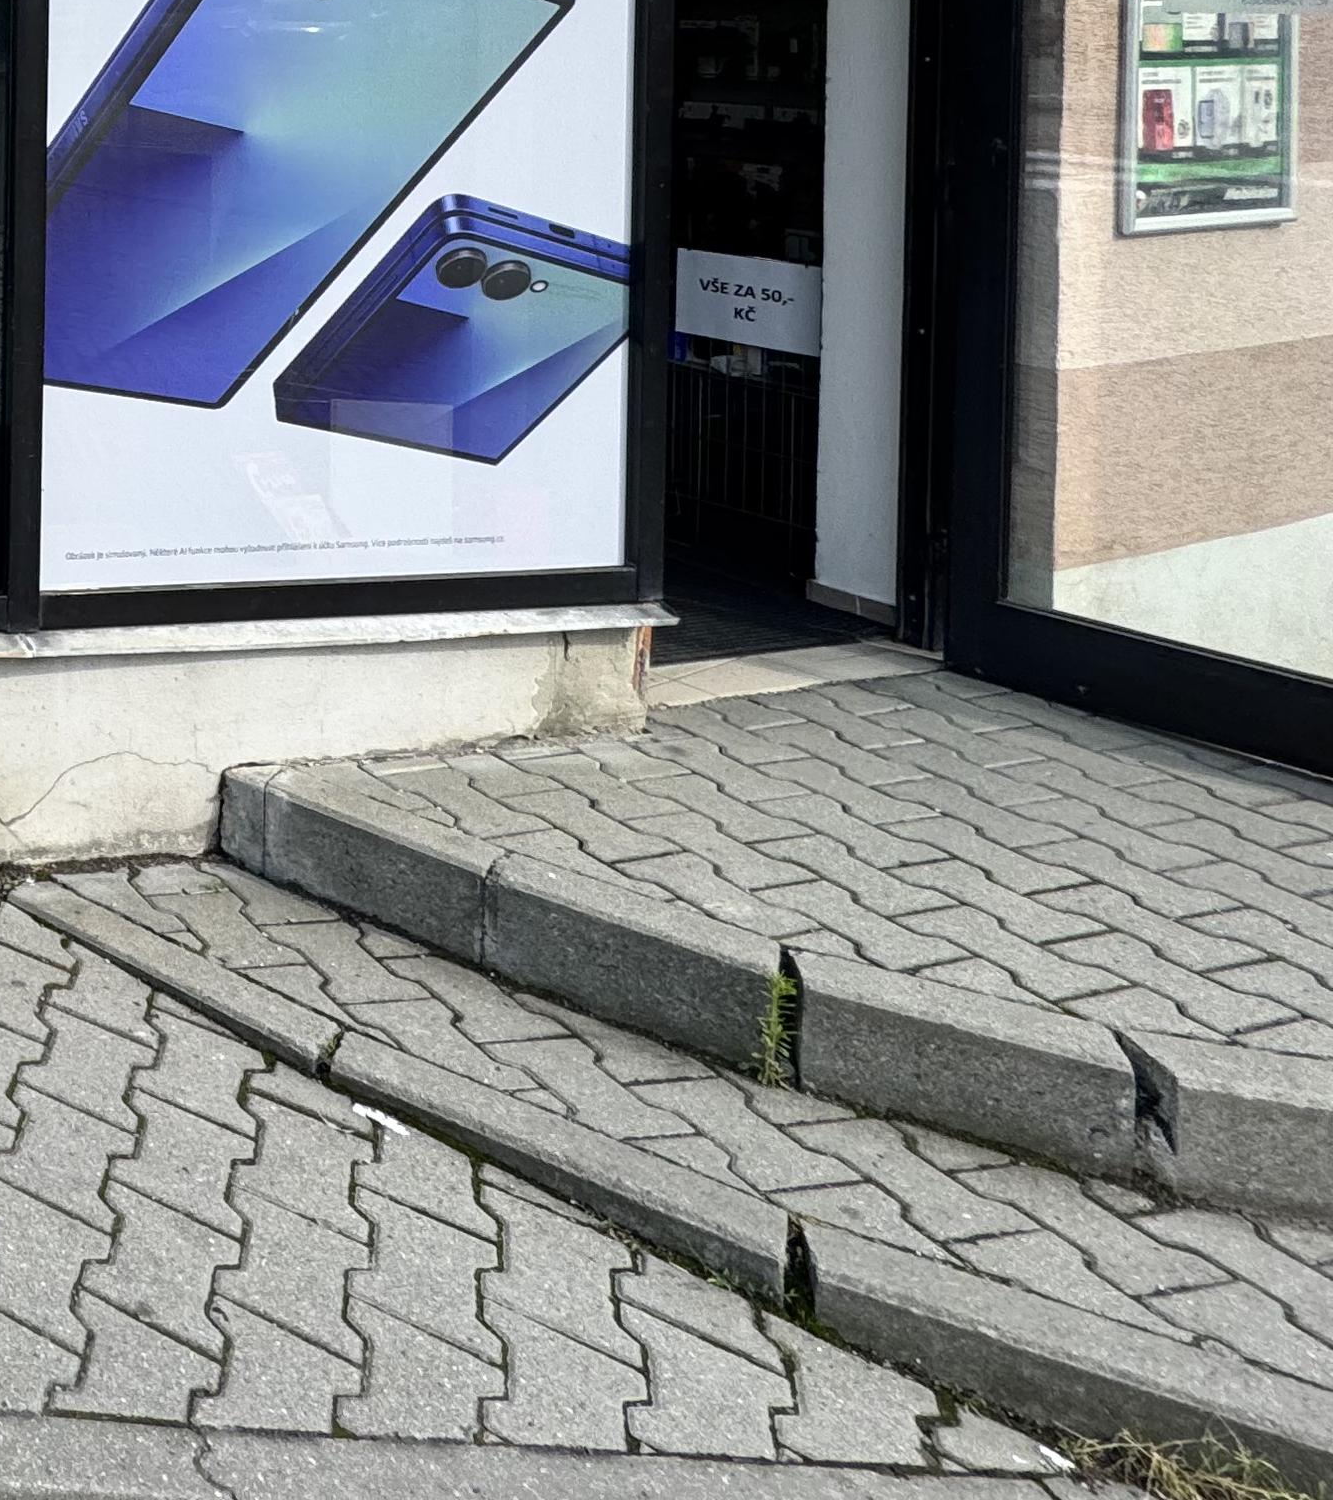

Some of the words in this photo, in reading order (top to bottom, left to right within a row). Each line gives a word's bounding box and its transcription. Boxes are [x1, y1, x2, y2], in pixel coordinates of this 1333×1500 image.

[699, 277, 730, 295] VŠE
[733, 283, 756, 300] ZA
[734, 306, 758, 322] KČ
